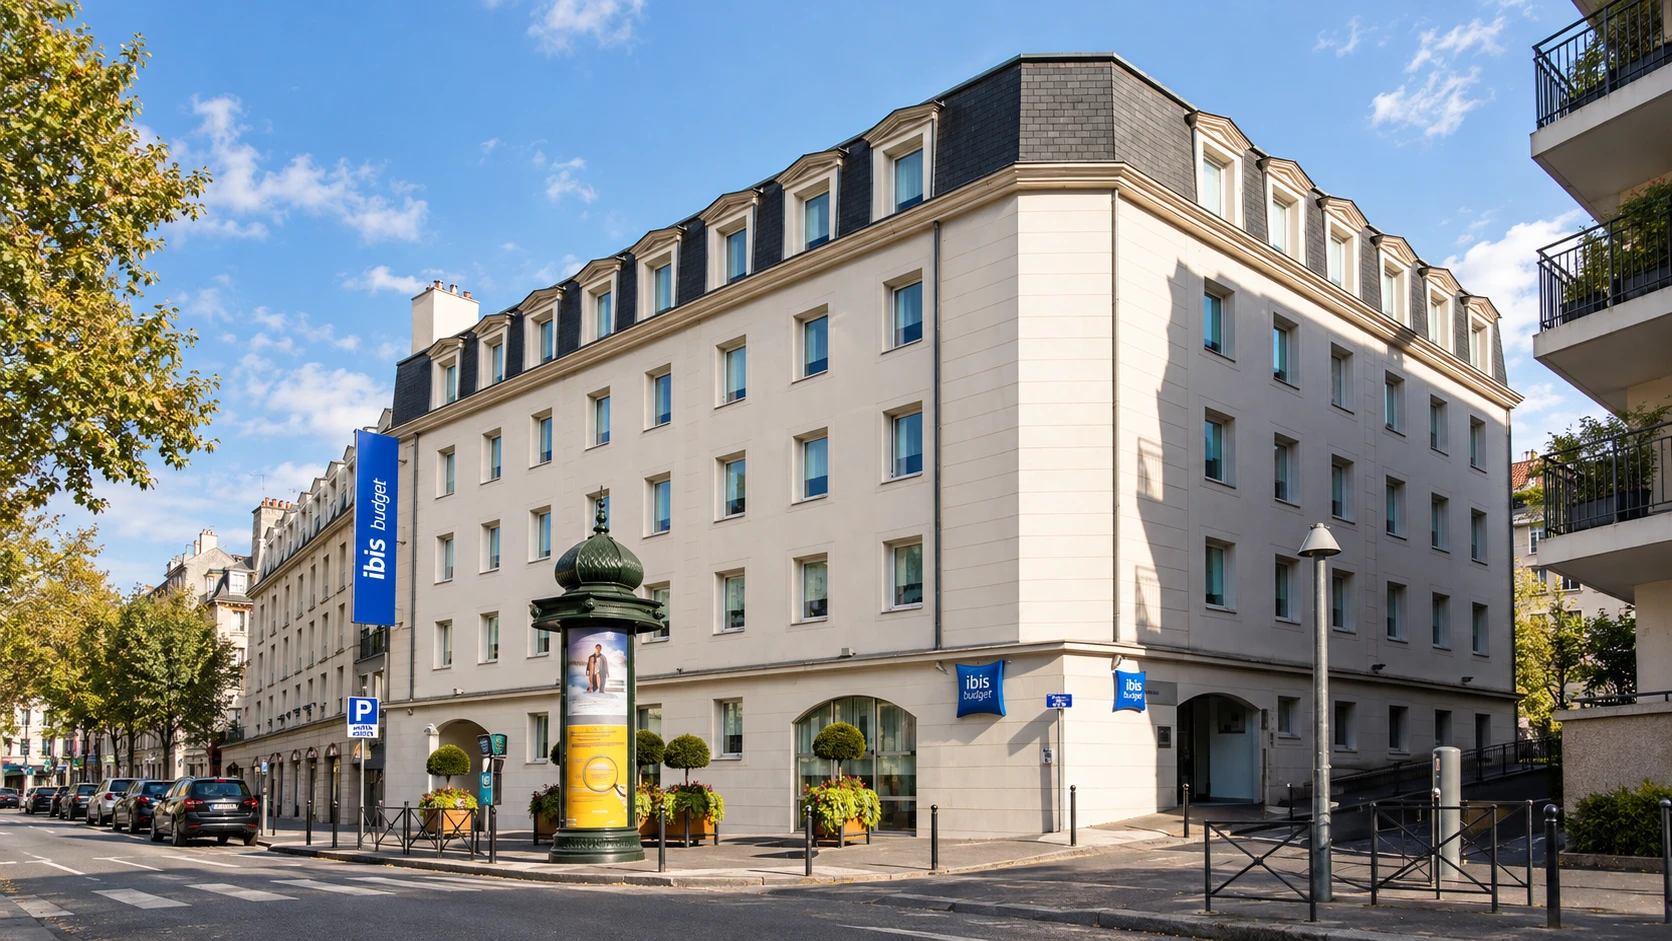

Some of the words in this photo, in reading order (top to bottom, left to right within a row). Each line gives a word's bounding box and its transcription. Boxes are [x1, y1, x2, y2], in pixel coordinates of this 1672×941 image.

[370, 478, 390, 531] budget
[363, 538, 386, 579] ibis
[966, 674, 990, 690] ibis
[1126, 678, 1142, 691] ibis
[963, 690, 992, 702] budget
[356, 700, 372, 721] P
